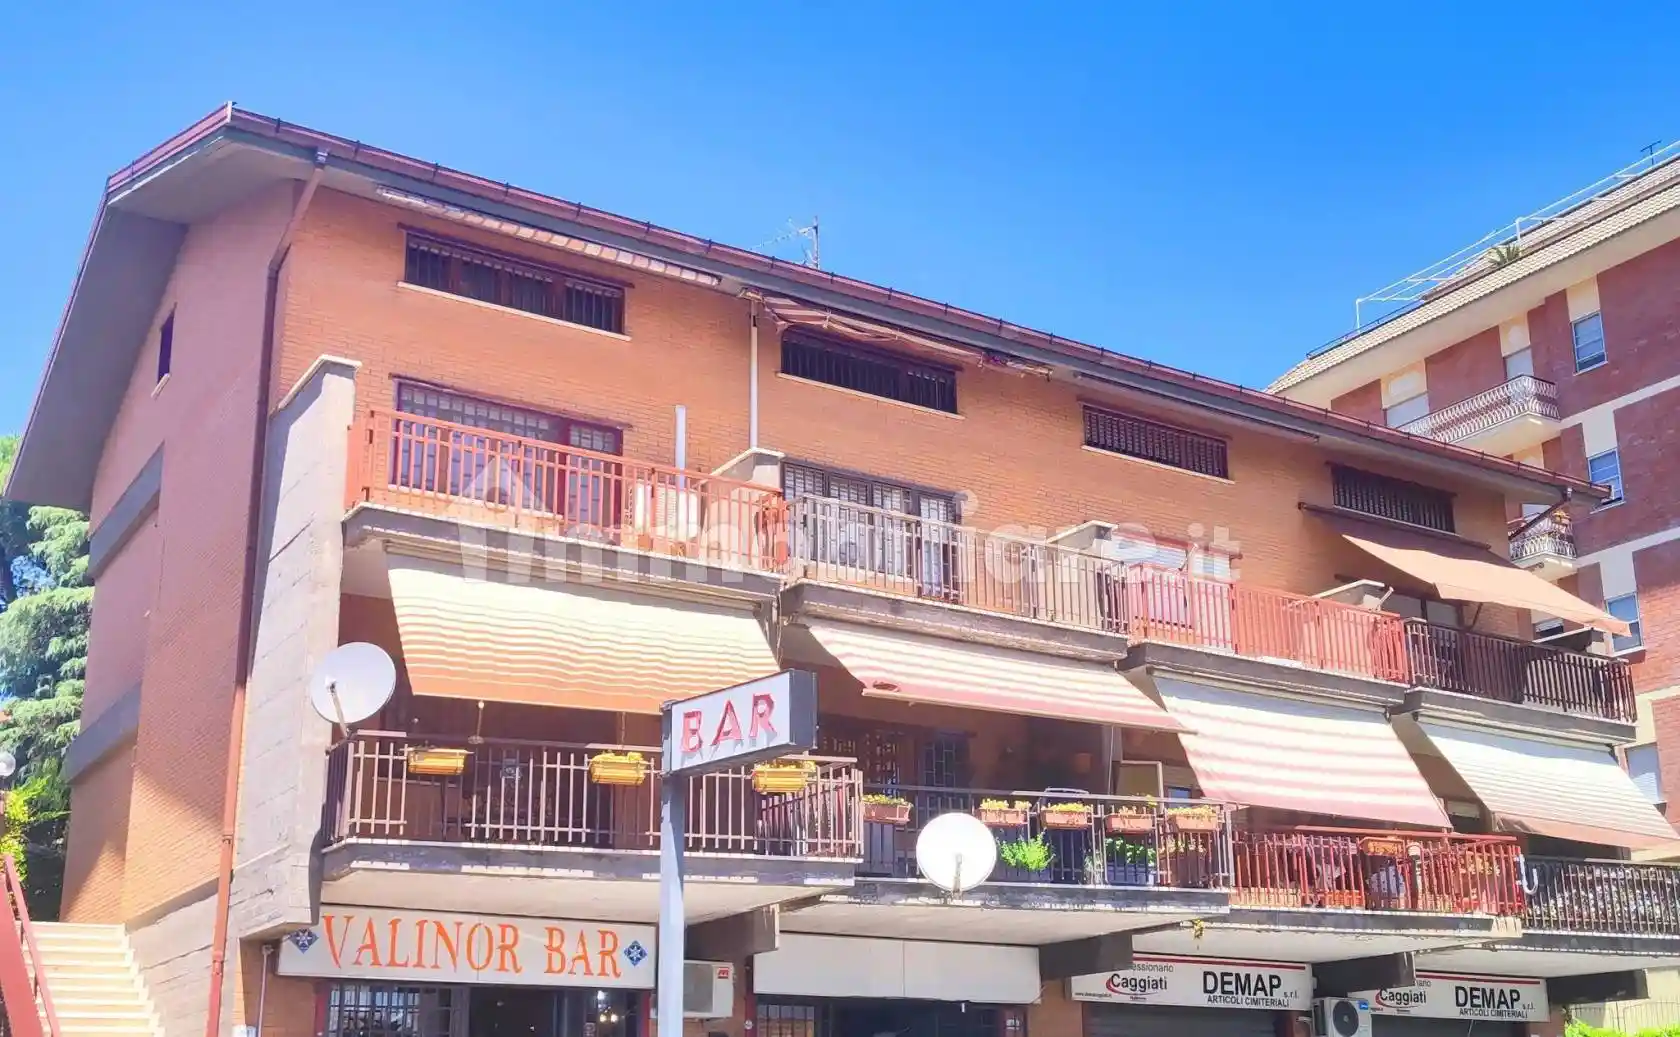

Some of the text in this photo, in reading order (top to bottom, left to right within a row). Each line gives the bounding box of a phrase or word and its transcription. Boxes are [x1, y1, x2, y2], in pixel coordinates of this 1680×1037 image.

[680, 693, 778, 753] BAR
[322, 914, 622, 979] VALINOR BAR
[1132, 962, 1174, 973] essionario
[1110, 973, 1168, 993] Caggiati
[1203, 970, 1282, 997] DEMAP
[1207, 995, 1290, 1008] ARTICOLI CIMITERIALI
[1380, 988, 1427, 1006] Caggiati
[1455, 986, 1521, 1009] DEMAP
[1459, 1008, 1528, 1019] ARTICOLI CIMITERIALI
